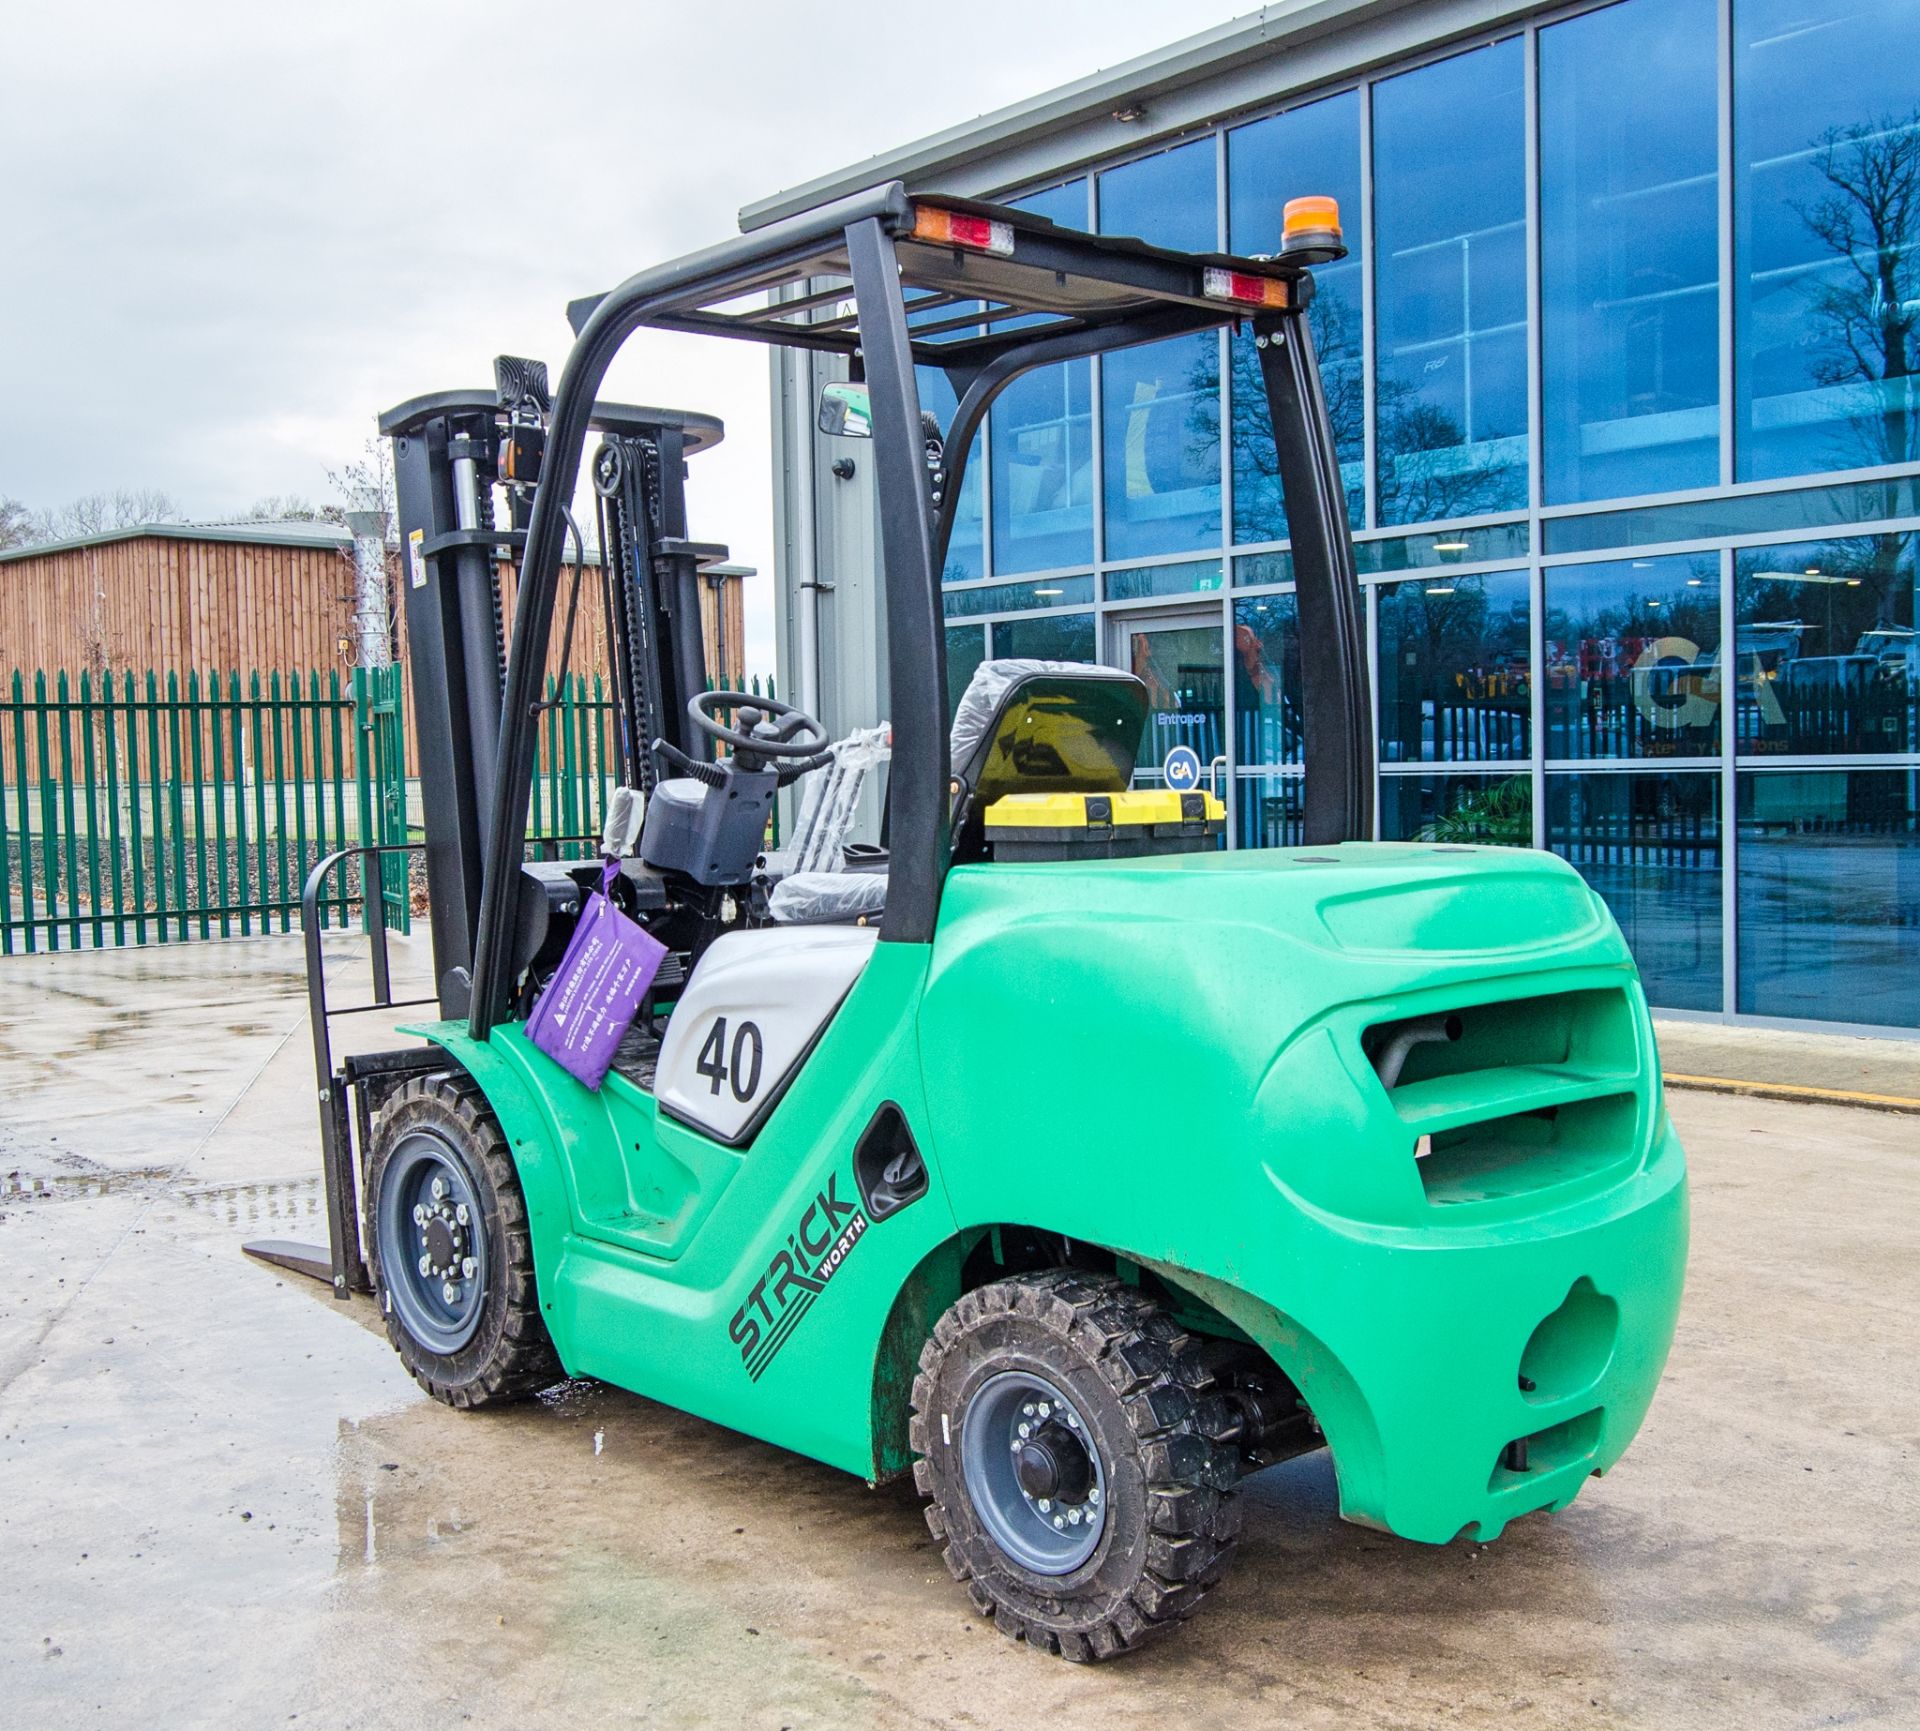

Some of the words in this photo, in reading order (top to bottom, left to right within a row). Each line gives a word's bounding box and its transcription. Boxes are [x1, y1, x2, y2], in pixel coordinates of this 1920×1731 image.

[1157, 712, 1206, 725] Entrance
[1169, 761, 1193, 780] GA
[696, 1016, 763, 1103] 40
[820, 1215, 866, 1278] WORTH
